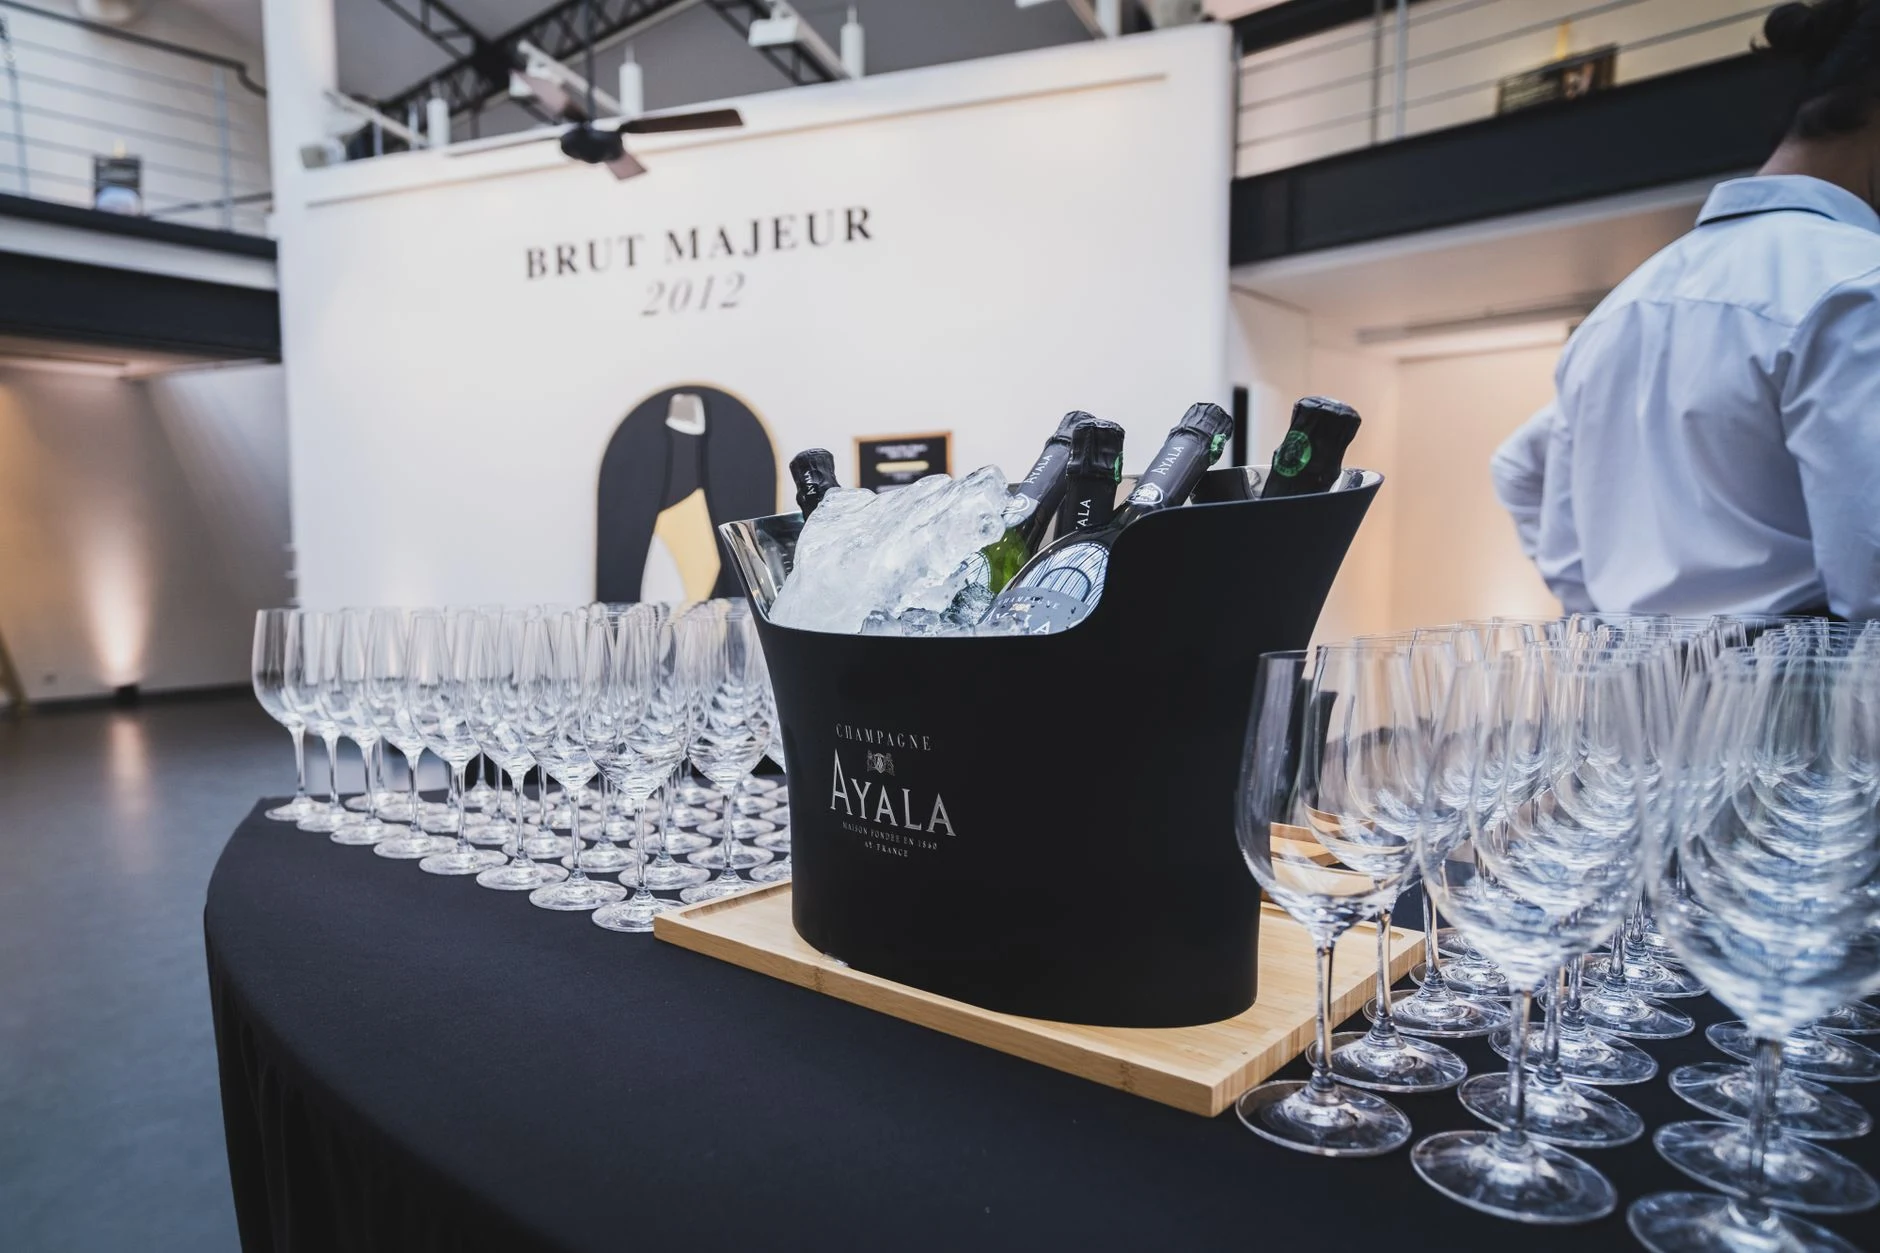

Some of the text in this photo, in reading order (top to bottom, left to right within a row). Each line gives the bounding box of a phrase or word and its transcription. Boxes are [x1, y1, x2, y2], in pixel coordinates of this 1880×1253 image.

[525, 205, 874, 281] BRUT MAJEUR
[640, 271, 747, 318] 2012
[1023, 454, 1053, 484] AYALA
[1150, 445, 1185, 476] AYALA
[835, 723, 932, 752] CHAMPAGNE
[829, 747, 958, 837] AYALA
[842, 820, 869, 836] MAISON
[876, 843, 909, 858] FRANCE
